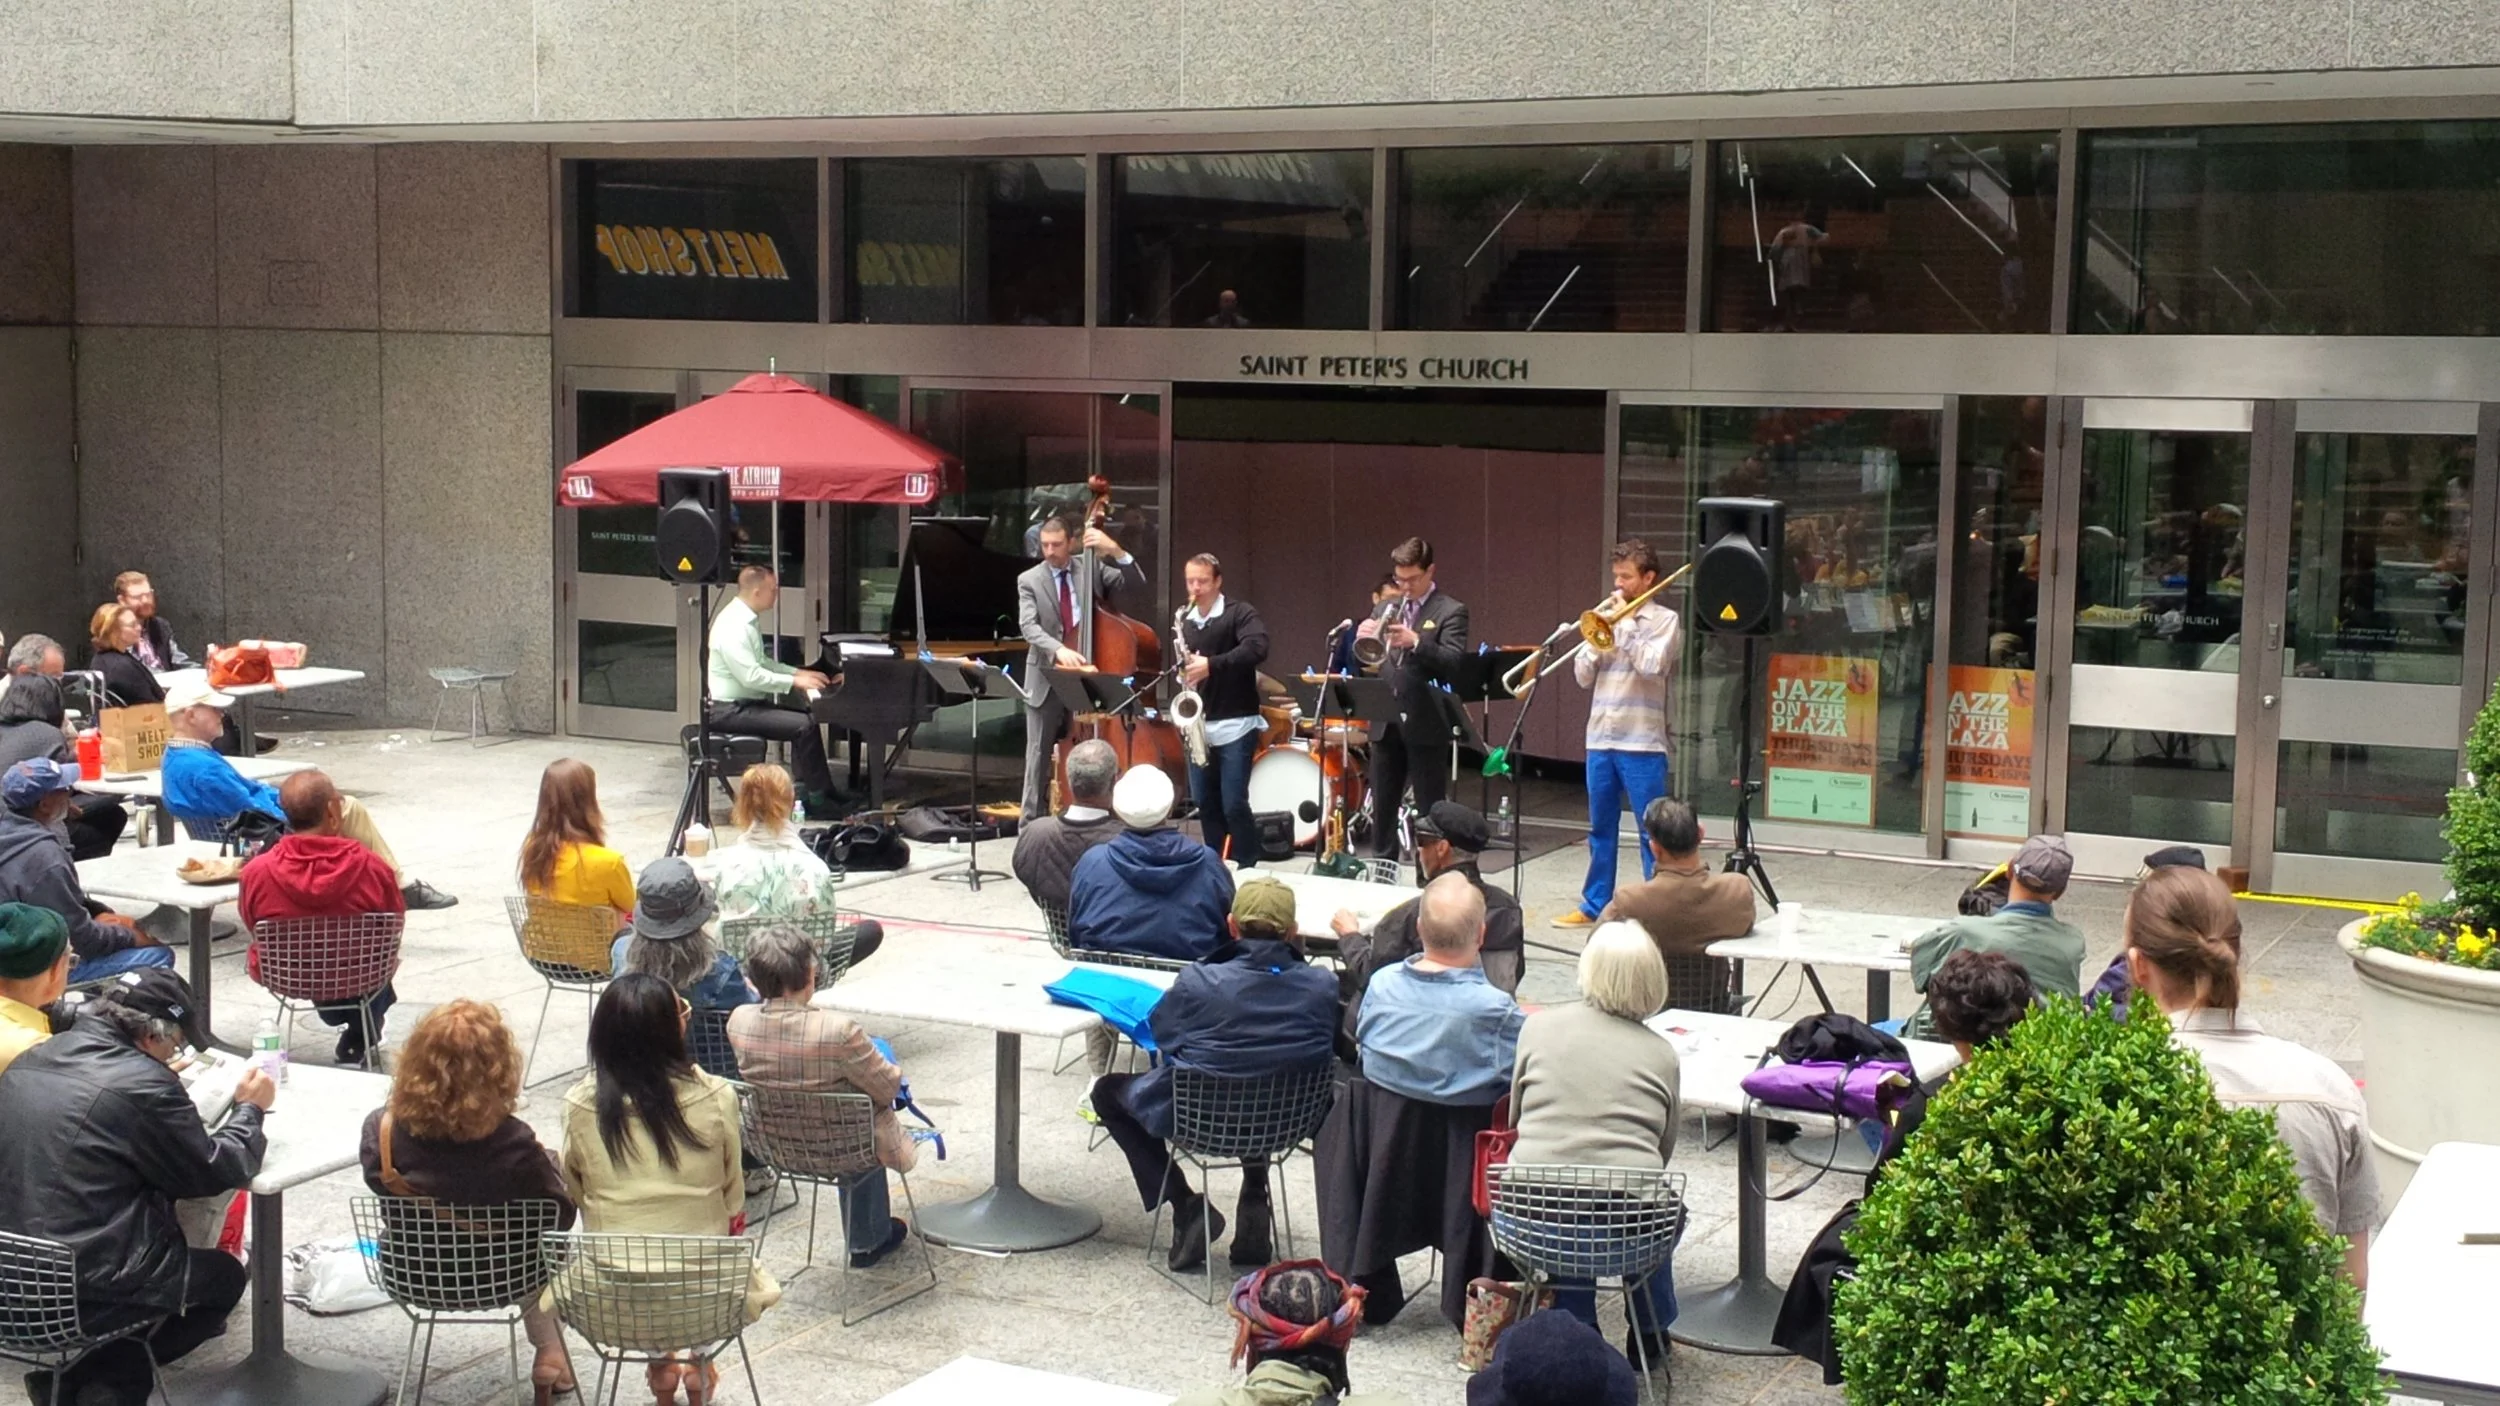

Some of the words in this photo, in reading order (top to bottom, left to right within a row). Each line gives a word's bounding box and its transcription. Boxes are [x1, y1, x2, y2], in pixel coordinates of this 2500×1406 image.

[1239, 355, 1309, 377] SAINT
[1319, 356, 1408, 379] PETER'S
[1418, 358, 1529, 380] CHURCH
[742, 466, 780, 485] ATRIUM
[1771, 678, 1846, 702] JAZZ
[1772, 700, 1801, 716] ON
[1806, 702, 1846, 720] THE
[1948, 691, 2009, 716] AZZ
[1771, 715, 1848, 737] PLAZA
[1947, 713, 1961, 729] N
[1966, 714, 2009, 733] THE
[137, 729, 166, 744] MELT
[1947, 728, 2010, 751] LAZA
